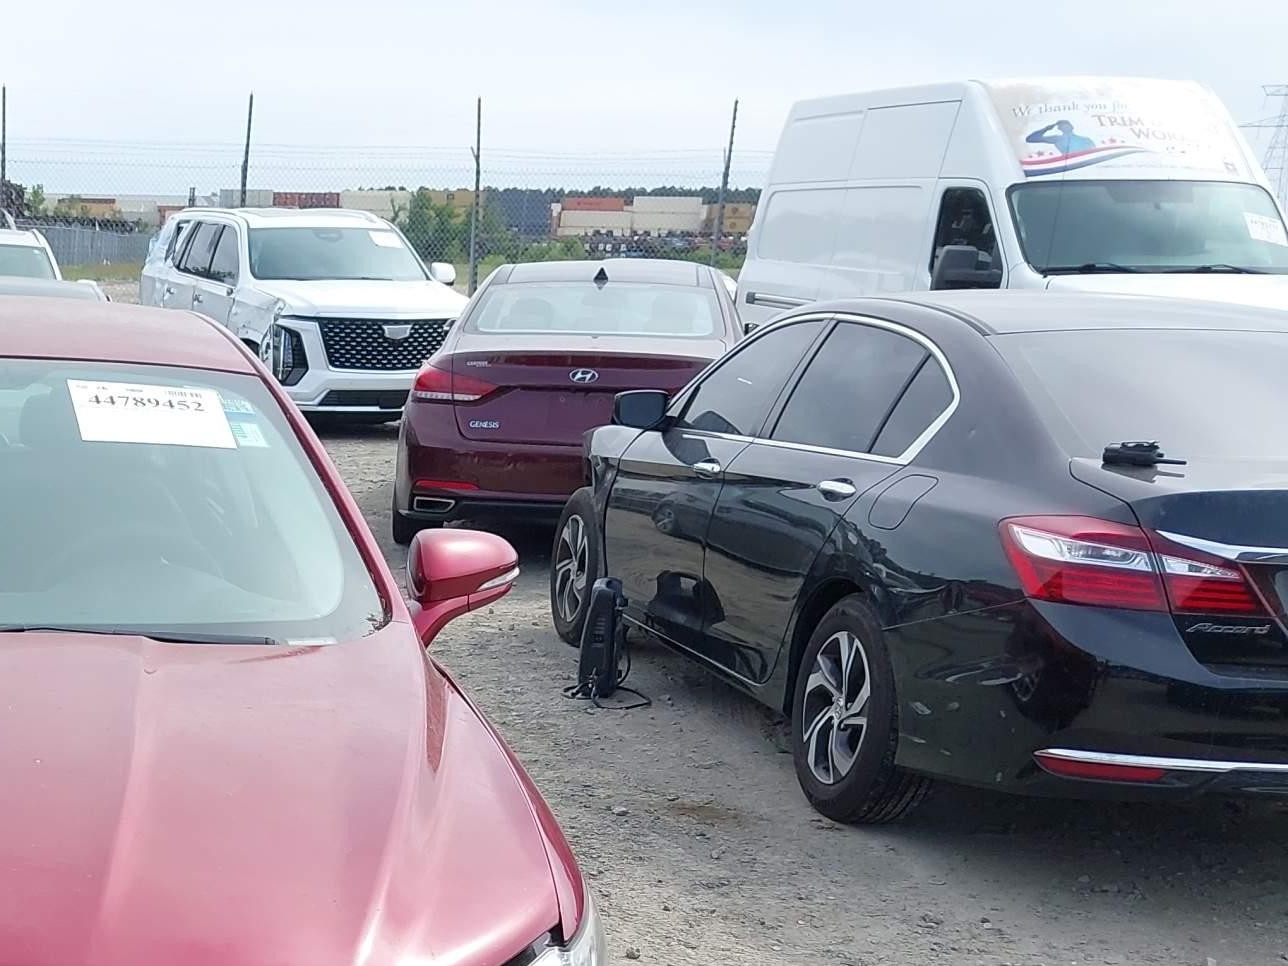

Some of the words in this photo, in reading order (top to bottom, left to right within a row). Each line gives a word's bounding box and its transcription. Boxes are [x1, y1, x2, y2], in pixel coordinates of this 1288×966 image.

[1012, 105, 1032, 118] We
[1038, 100, 1080, 114] thank
[1083, 102, 1108, 114] you
[1092, 114, 1145, 127] TRIM
[88, 393, 206, 412] 44789452
[468, 420, 500, 429] GENESIS
[1185, 622, 1272, 634] Accord
